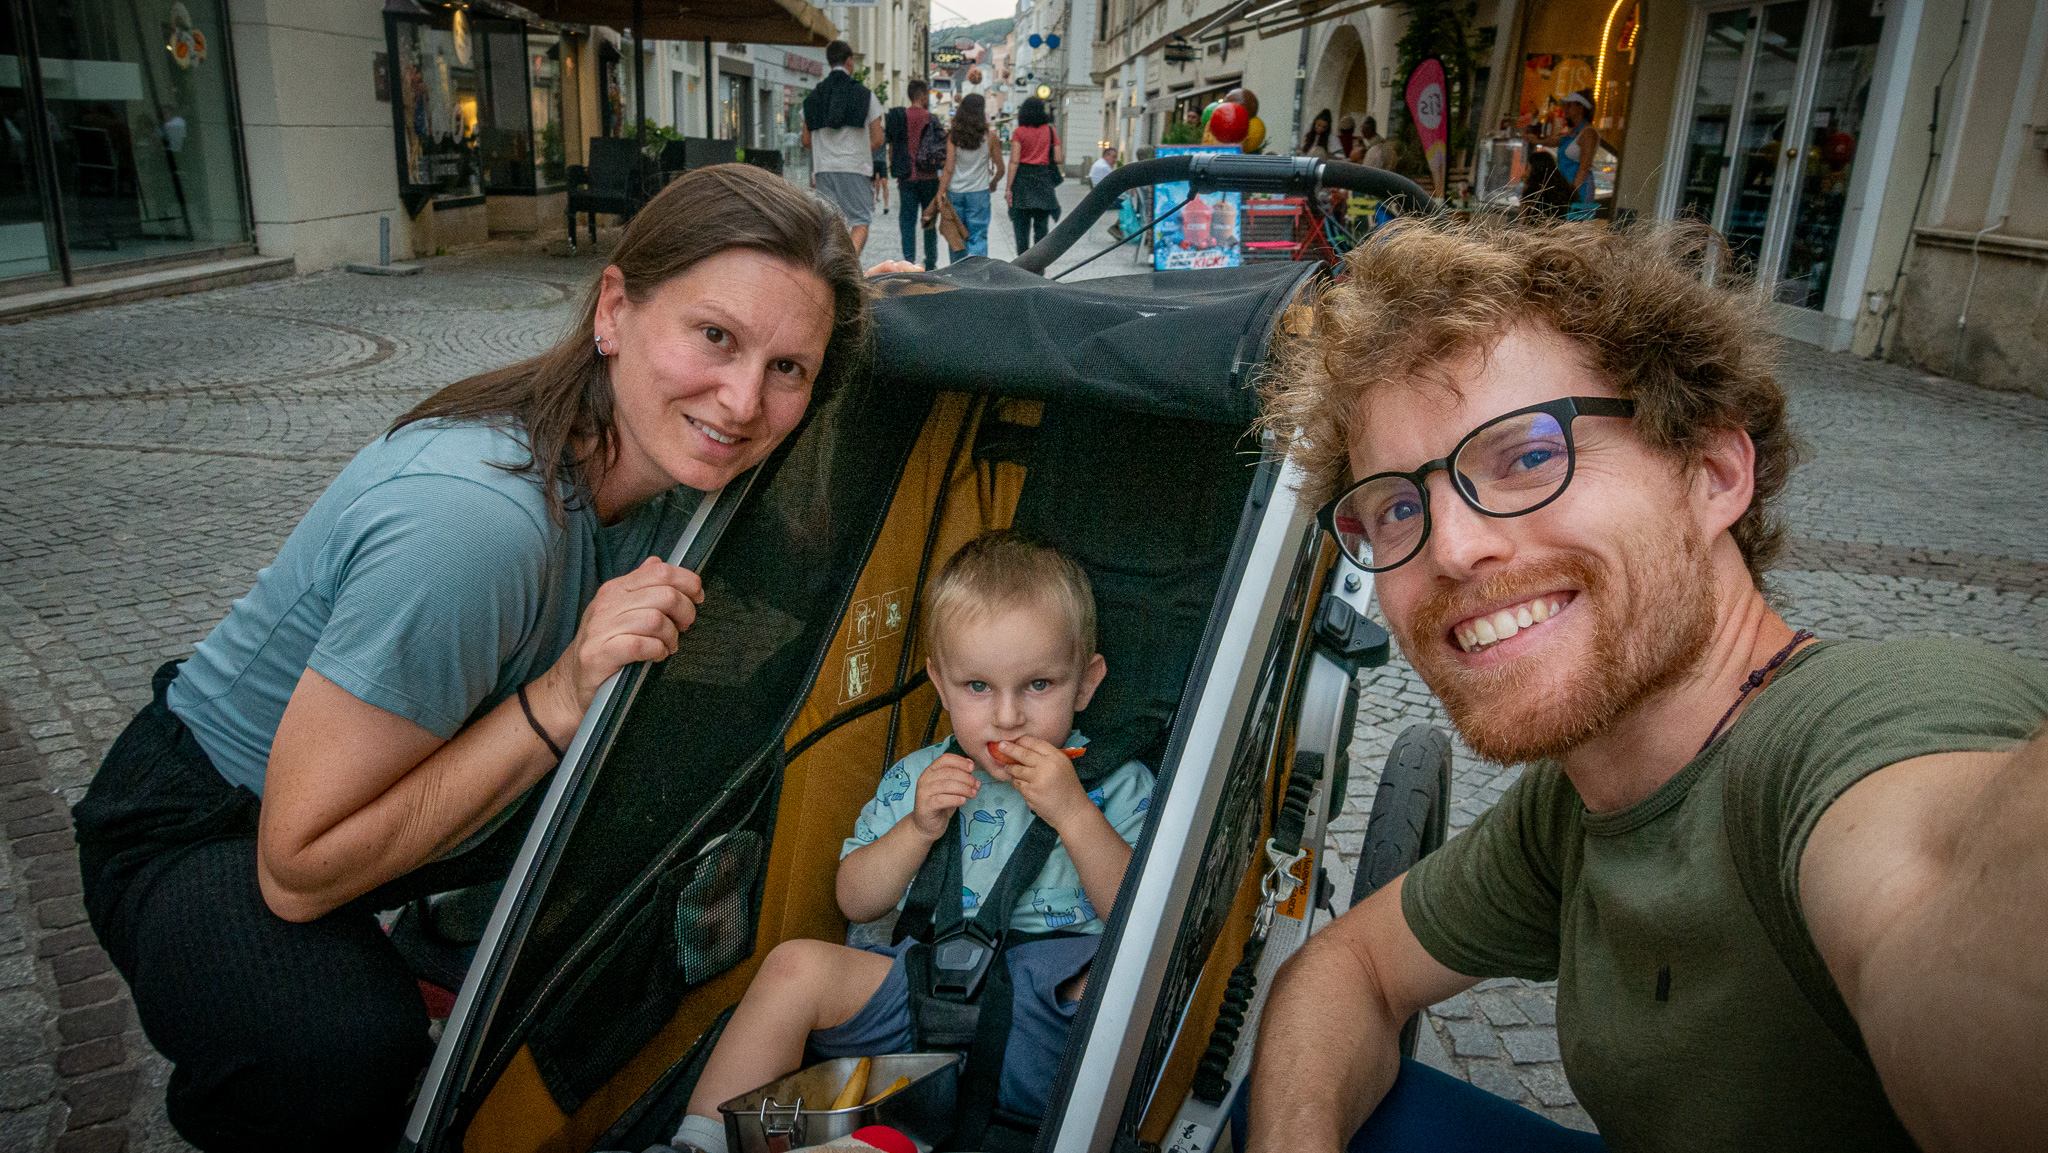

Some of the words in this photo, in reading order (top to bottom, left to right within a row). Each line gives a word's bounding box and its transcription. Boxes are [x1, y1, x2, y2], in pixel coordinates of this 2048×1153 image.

[1555, 66, 1589, 98] EIS
[1194, 255, 1226, 268] KICK!
[1300, 857, 1313, 895] WARNING
